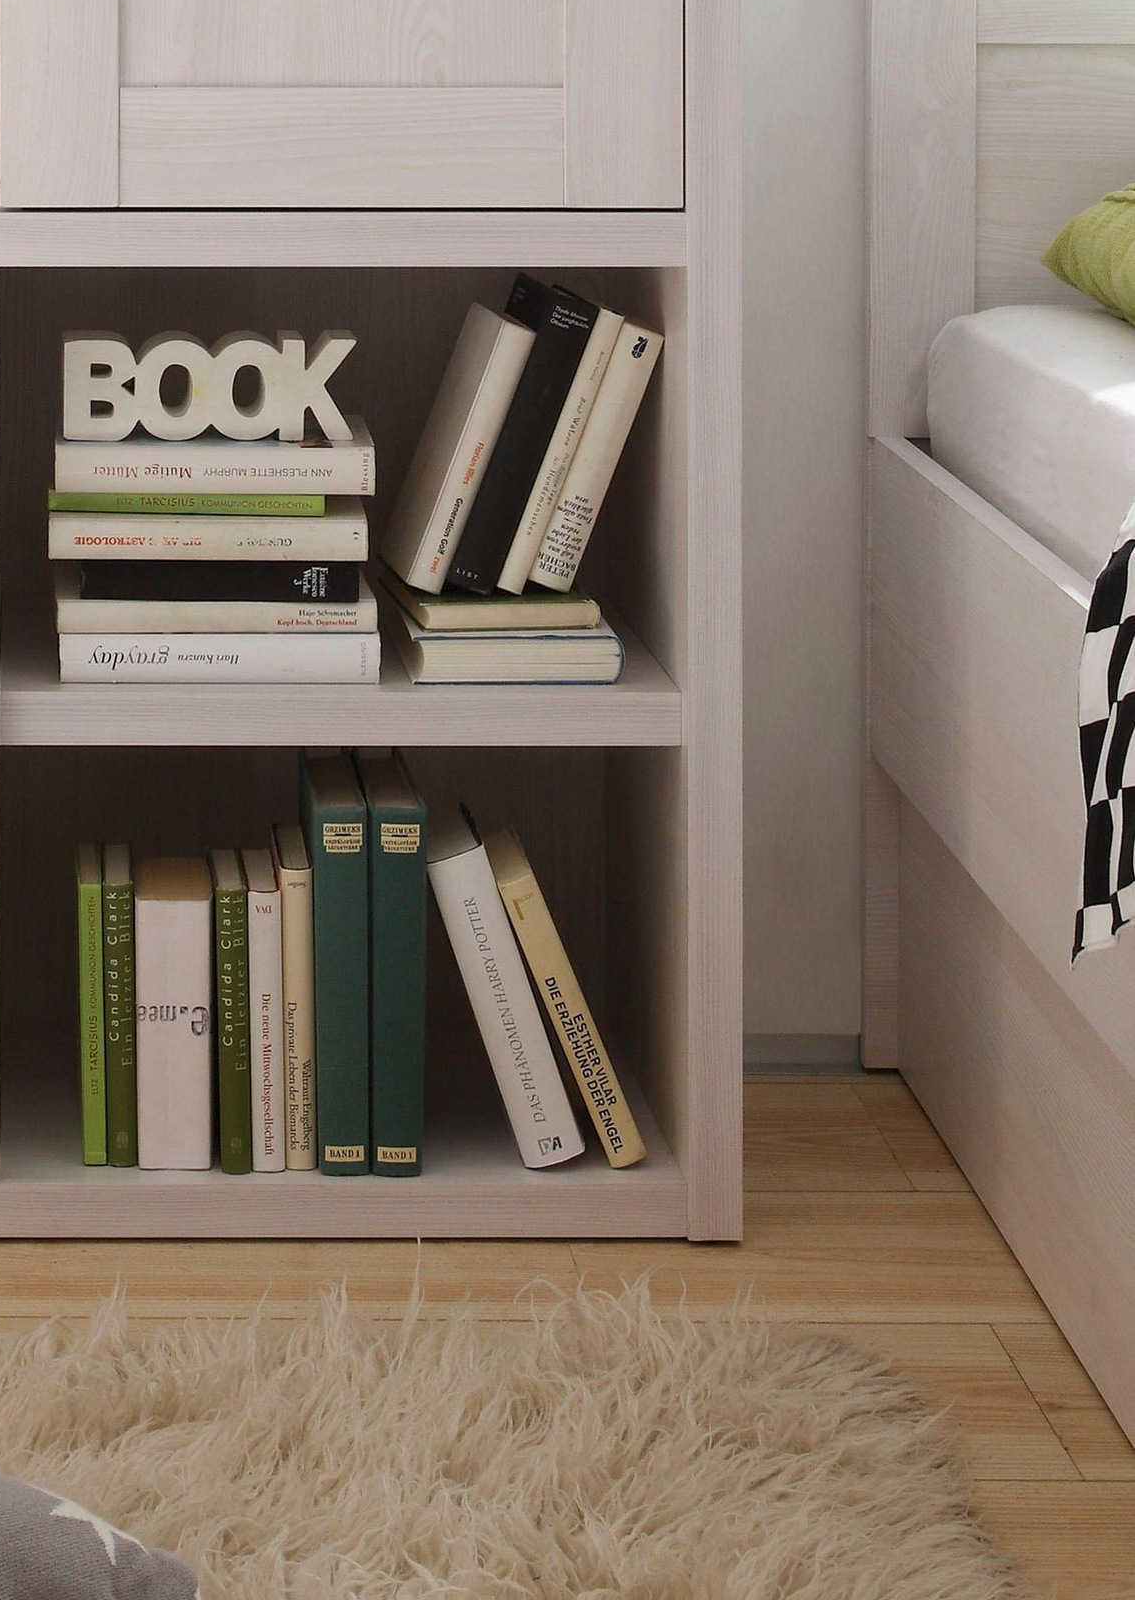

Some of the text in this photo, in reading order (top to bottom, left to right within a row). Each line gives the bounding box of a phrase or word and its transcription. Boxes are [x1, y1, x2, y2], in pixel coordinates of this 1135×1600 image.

[63, 332, 358, 441] BOOK
[93, 464, 192, 478] Mutige Mütter
[469, 441, 485, 466] Florian
[203, 467, 333, 478] ANN PLESHETTE MURPHY
[140, 497, 195, 507] TARCISIUS
[258, 501, 313, 509] GESCHICHTEN
[443, 497, 464, 538] Generation
[437, 538, 448, 556] Golf
[538, 551, 576, 572] BACHER
[293, 578, 302, 586] 3
[302, 569, 312, 595] Werke
[456, 567, 479, 580] LIST
[539, 561, 570, 578] PETER
[277, 619, 294, 627] Kopf
[88, 645, 170, 670] grayday
[177, 654, 240, 665] Hari Kunzru
[88, 896, 96, 951] GESCHICHTEN
[464, 897, 492, 952] POTTER
[88, 954, 98, 1009] KOMMUNION
[106, 892, 120, 1041] Candida Clark
[118, 891, 133, 1066] Ein letzter Blick
[219, 896, 233, 1047] Candida Clark
[232, 896, 246, 1071] Ein letzter Blick
[482, 956, 505, 1005] HARRY
[89, 1015, 98, 1071] TARCISIUS
[572, 1013, 617, 1106] ESTHER VILAR
[261, 993, 275, 1156] Die neue Mittwochsgesellschaft
[285, 1002, 300, 1151] Das private Leben der Bismarcks
[544, 976, 626, 1155] DIE ERZIEHUNG DER ENGEL
[300, 1059, 313, 1151] Waltraut Engelberg
[530, 1092, 546, 1124] DAS
[329, 1149, 354, 1158] BAND
[382, 1150, 407, 1160] BAND
